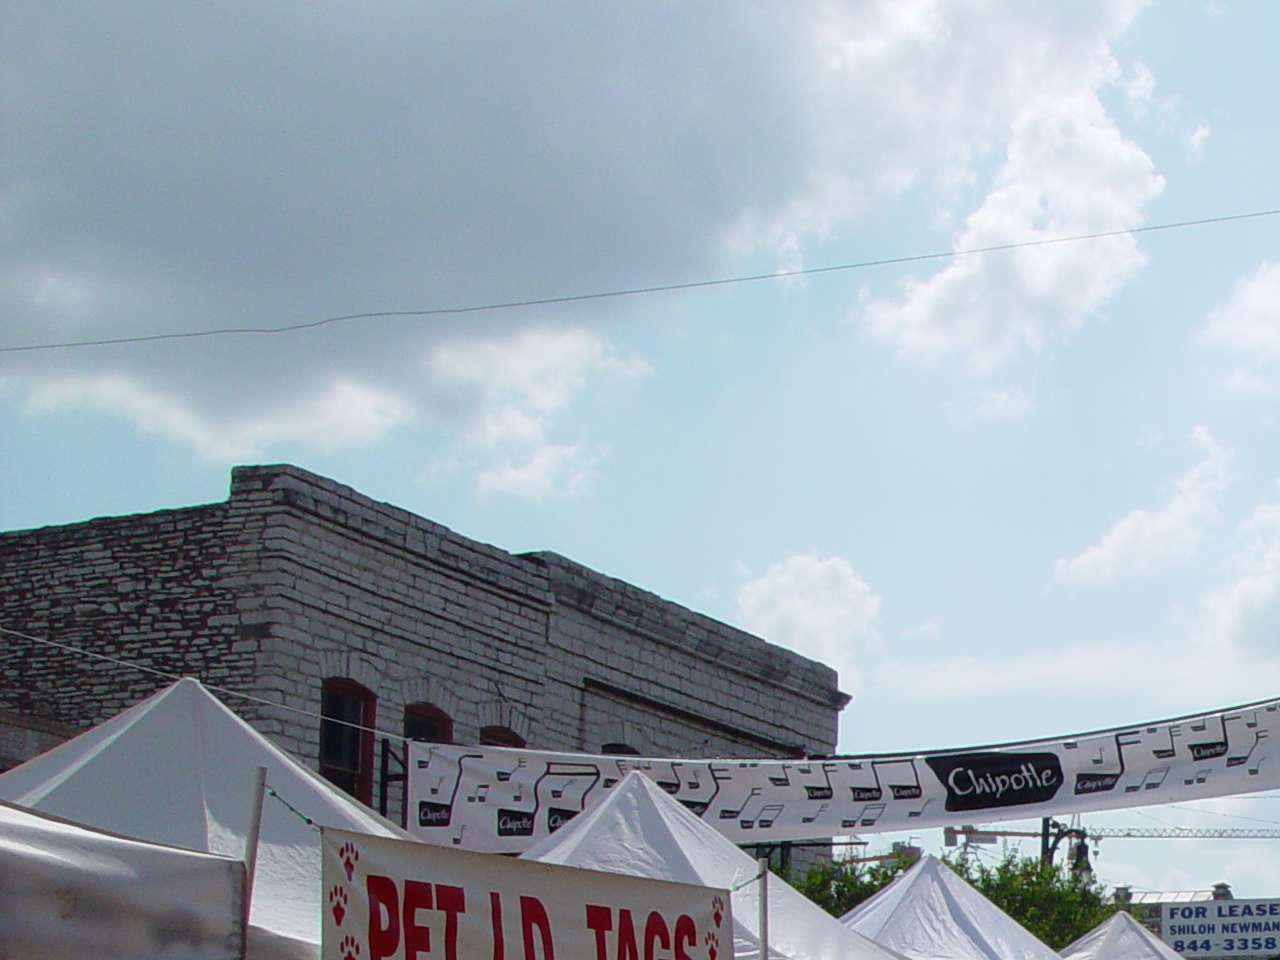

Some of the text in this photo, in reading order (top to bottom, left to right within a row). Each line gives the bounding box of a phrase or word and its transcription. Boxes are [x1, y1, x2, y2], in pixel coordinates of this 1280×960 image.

[948, 762, 1057, 798] Chipotle
[420, 806, 450, 824] Chipotle
[499, 811, 532, 832] Chipotle
[1169, 903, 1280, 920] FOR LEASE
[1169, 921, 1280, 936] SHILOH NEWMAN
[1173, 937, 1277, 953] 844-3358
